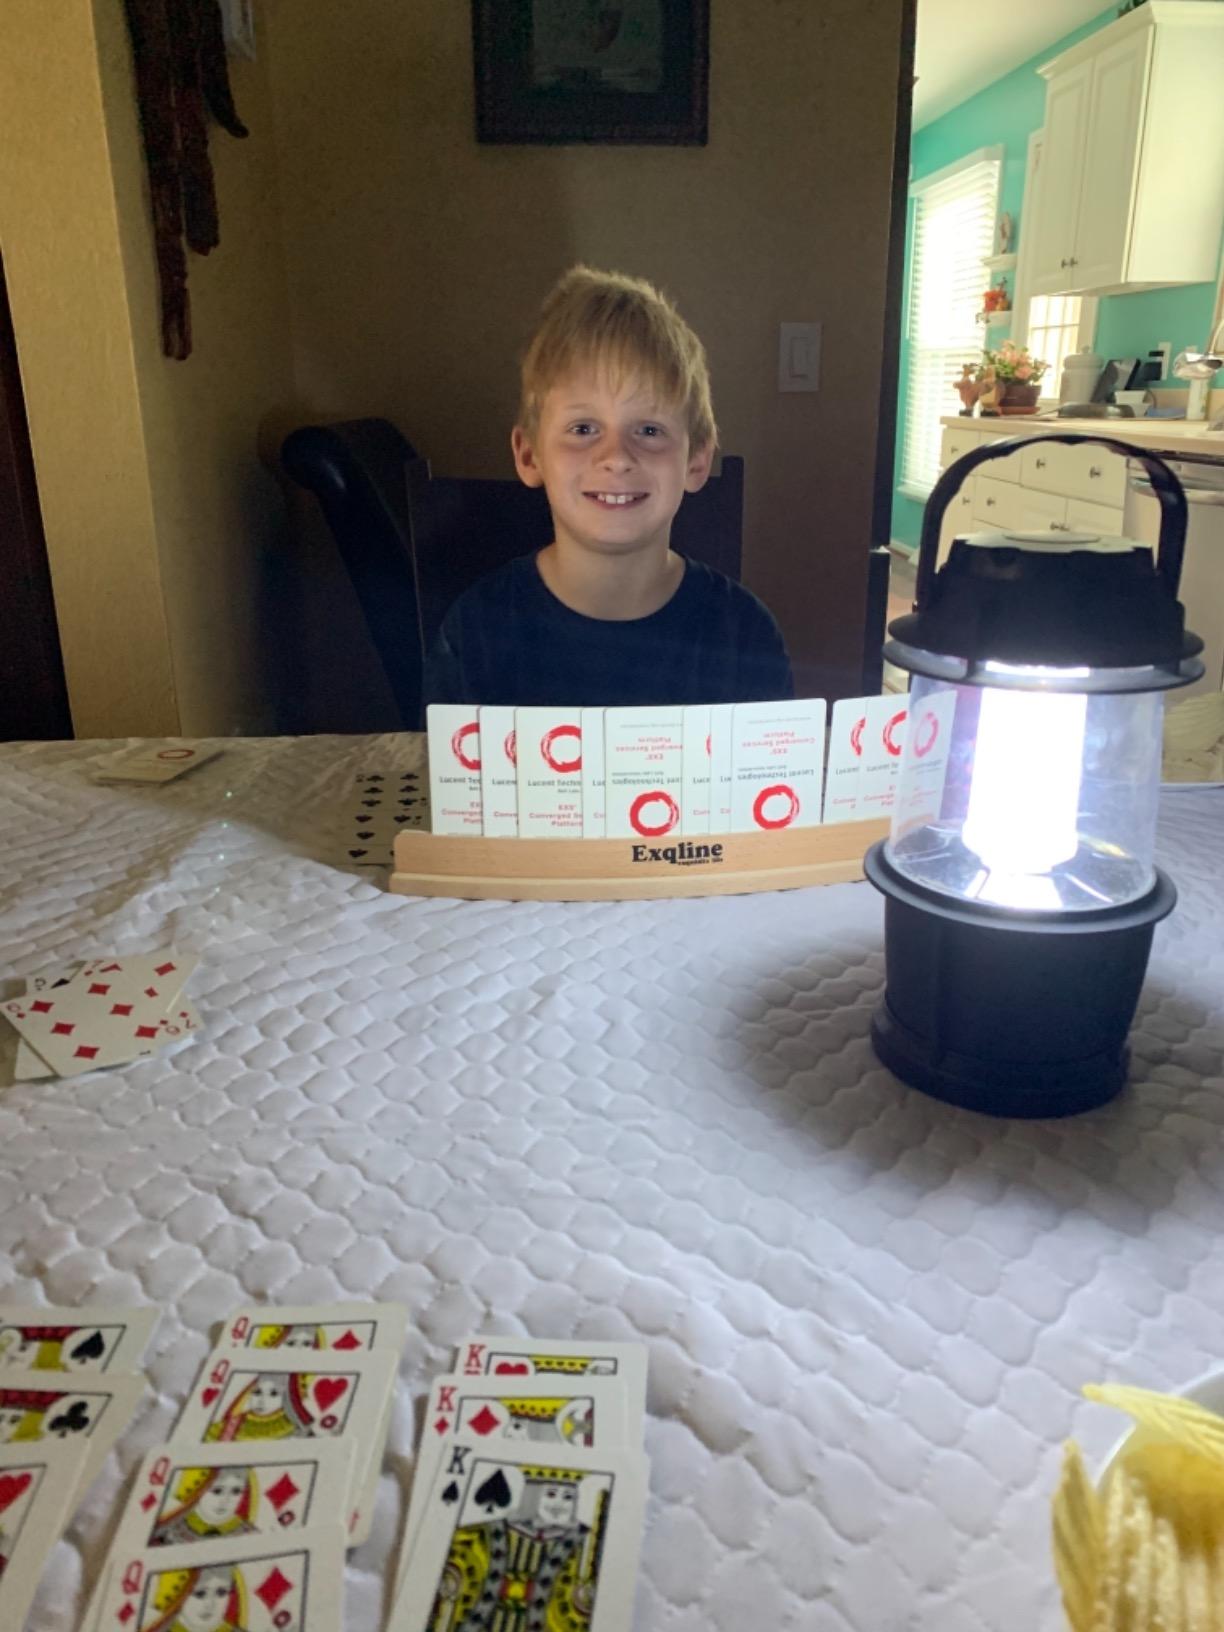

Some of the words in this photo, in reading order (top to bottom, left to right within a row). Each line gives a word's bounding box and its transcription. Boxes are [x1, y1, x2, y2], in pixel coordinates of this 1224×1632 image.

[631, 841, 723, 864] Exqline
[231, 1316, 250, 1341] Q
[464, 1344, 487, 1370] K
[211, 1359, 231, 1384] Q
[435, 1386, 458, 1413] K
[149, 1457, 171, 1486] Q
[446, 1446, 472, 1476] K
[122, 1560, 144, 1595] Q
